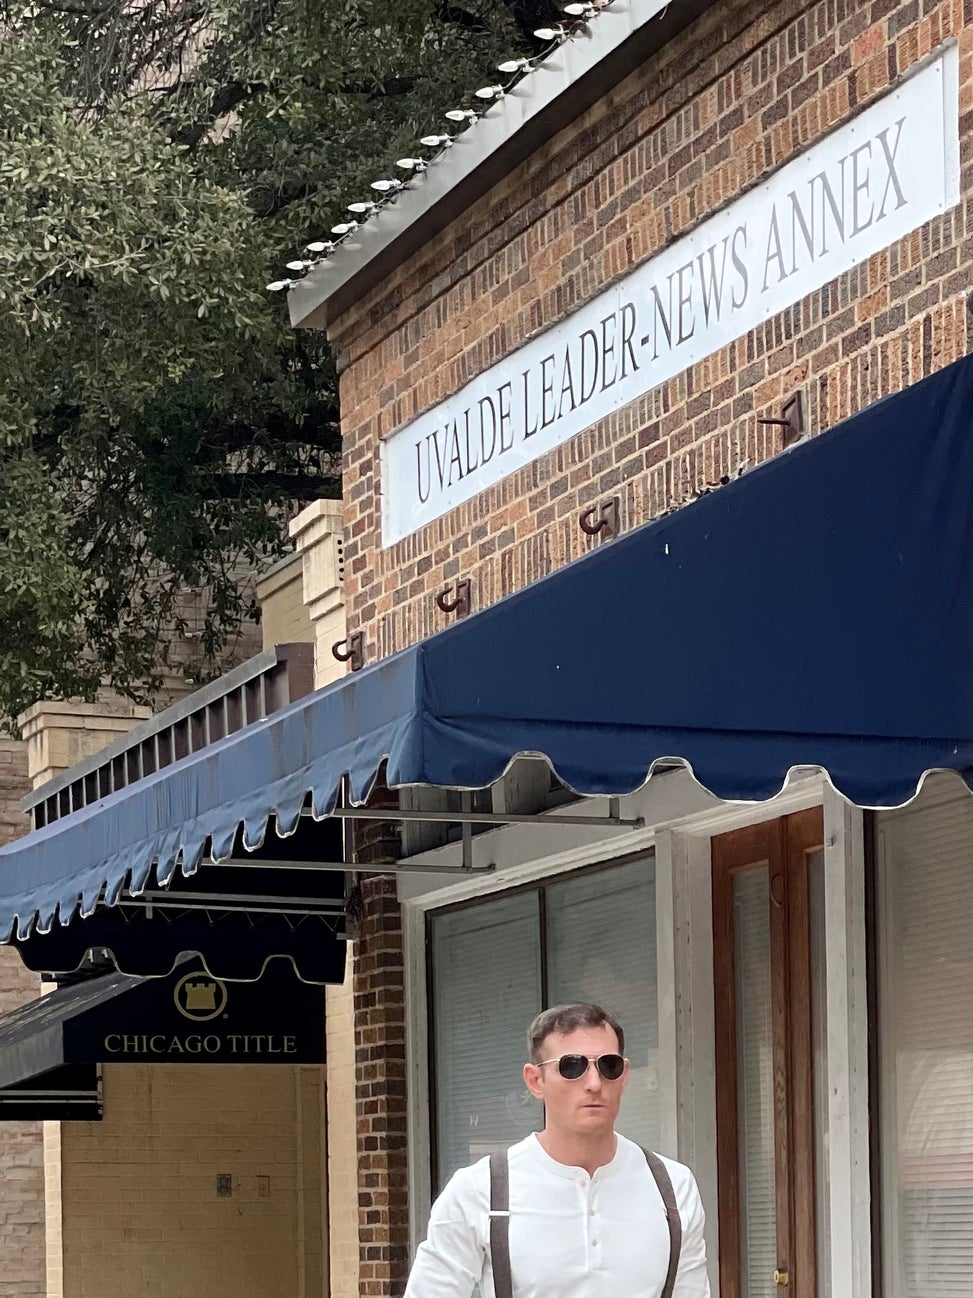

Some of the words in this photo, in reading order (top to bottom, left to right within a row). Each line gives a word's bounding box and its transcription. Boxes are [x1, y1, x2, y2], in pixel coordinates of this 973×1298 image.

[415, 380, 513, 504] UVALDE
[521, 223, 749, 441] LEADER-NEWS
[760, 116, 909, 293] ANNEX
[104, 1033, 221, 1054] CHICAGO
[227, 1034, 297, 1053] TITLE
